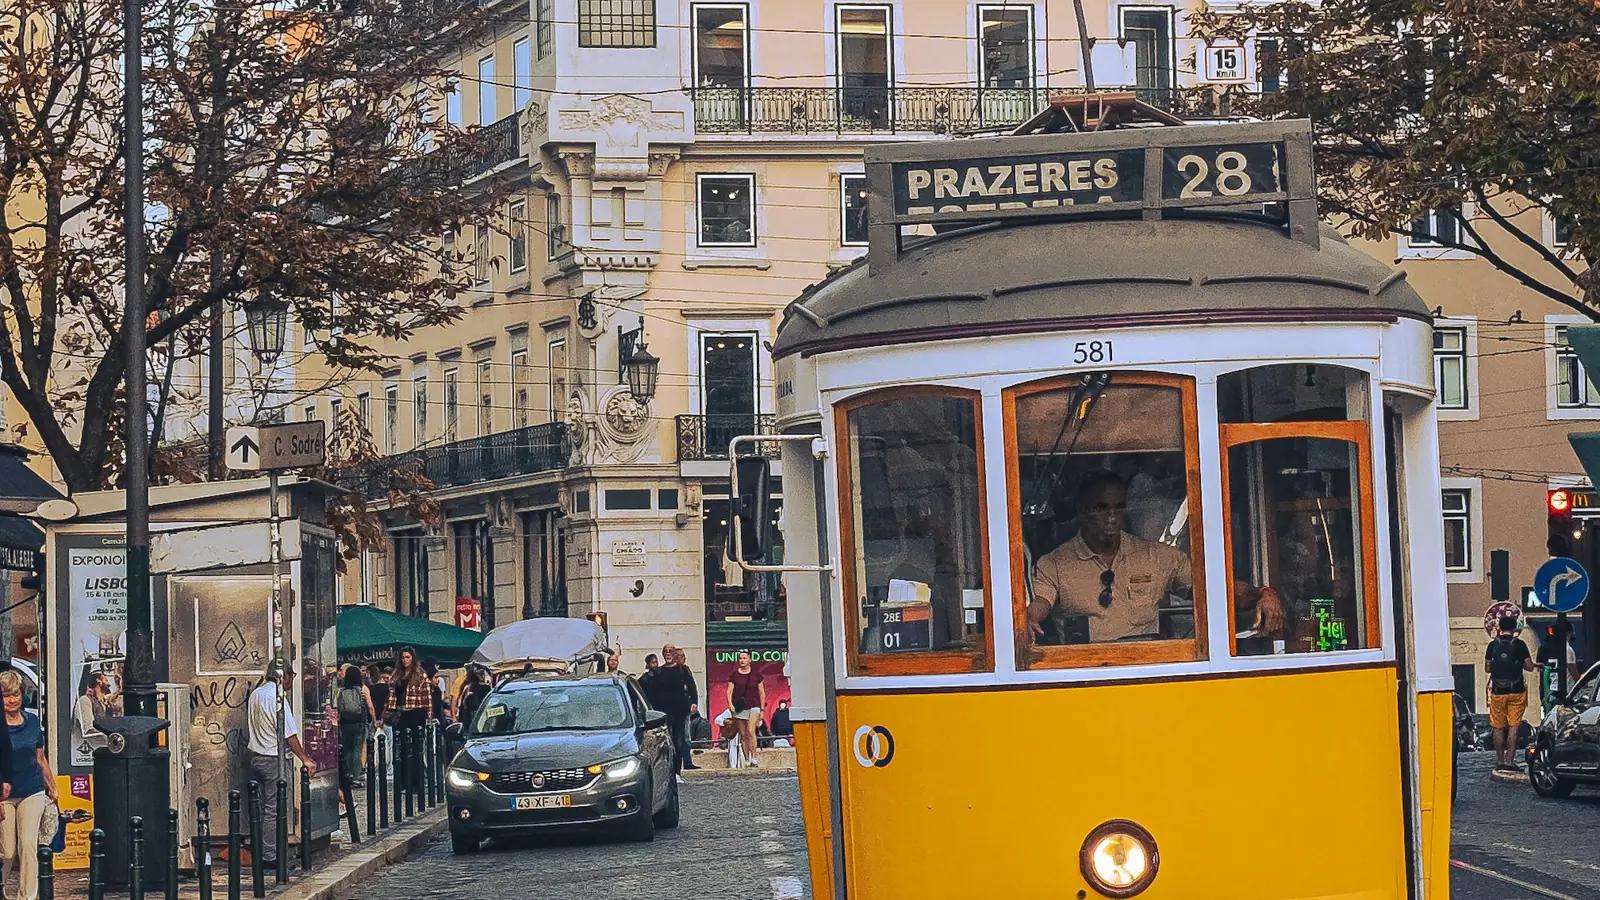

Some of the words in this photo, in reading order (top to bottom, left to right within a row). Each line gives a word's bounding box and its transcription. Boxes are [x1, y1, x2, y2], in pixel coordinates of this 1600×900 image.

[1214, 49, 1237, 69] 15
[907, 158, 1119, 199] PRAZERES
[1177, 151, 1252, 199] 28
[1073, 340, 1113, 364] 581
[290, 433, 321, 456] Sodré
[72, 555, 126, 566] EXPONOI
[883, 612, 901, 623] 28E
[884, 632, 900, 648] 01
